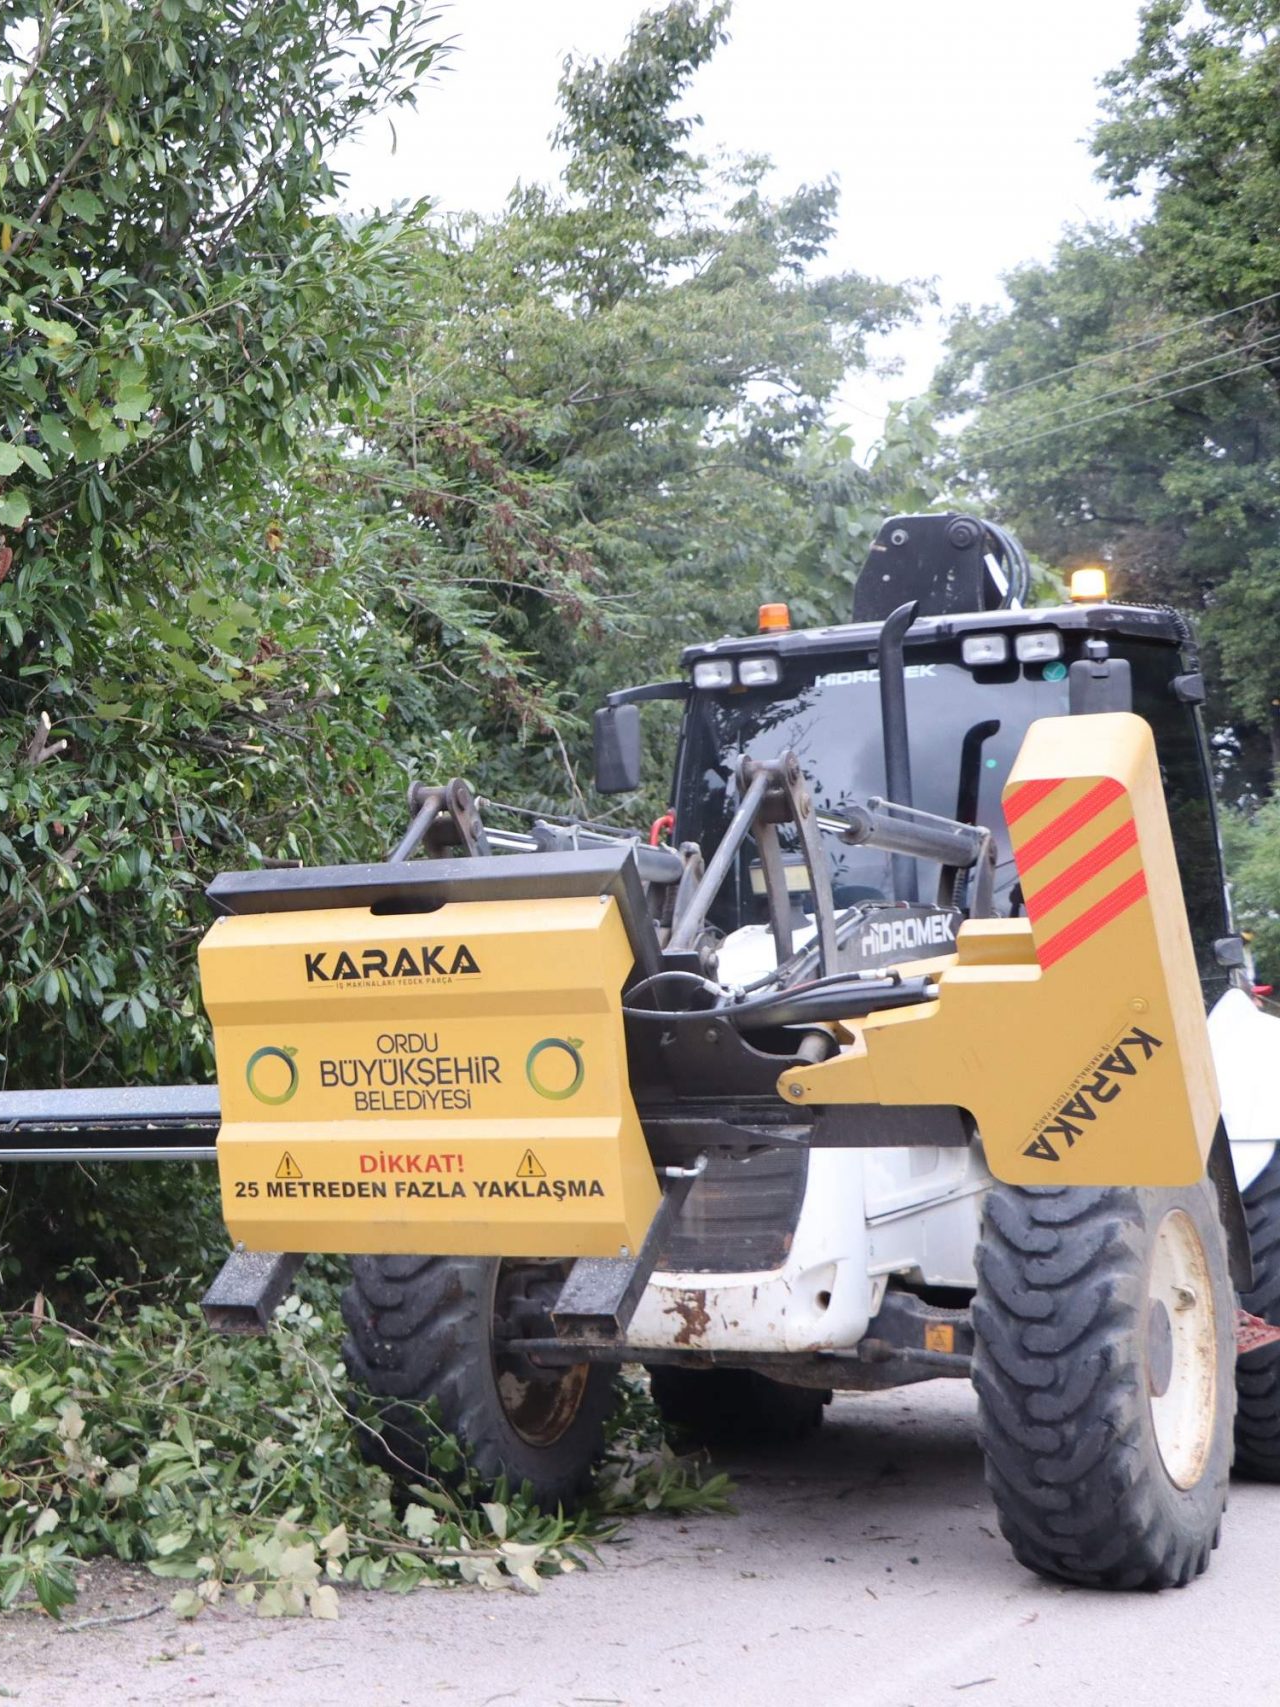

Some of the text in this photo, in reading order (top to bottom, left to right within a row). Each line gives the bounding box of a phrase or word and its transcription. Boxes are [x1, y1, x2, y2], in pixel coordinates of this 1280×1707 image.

[304, 943, 481, 982] KARAKA
[376, 1033, 439, 1055] ORDU
[1022, 1026, 1163, 1162] KARAKA
[359, 1150, 465, 1174] DİKKAT!
[234, 1179, 605, 1202] 25 METREDEN FAZLA YAKLAŞMA
